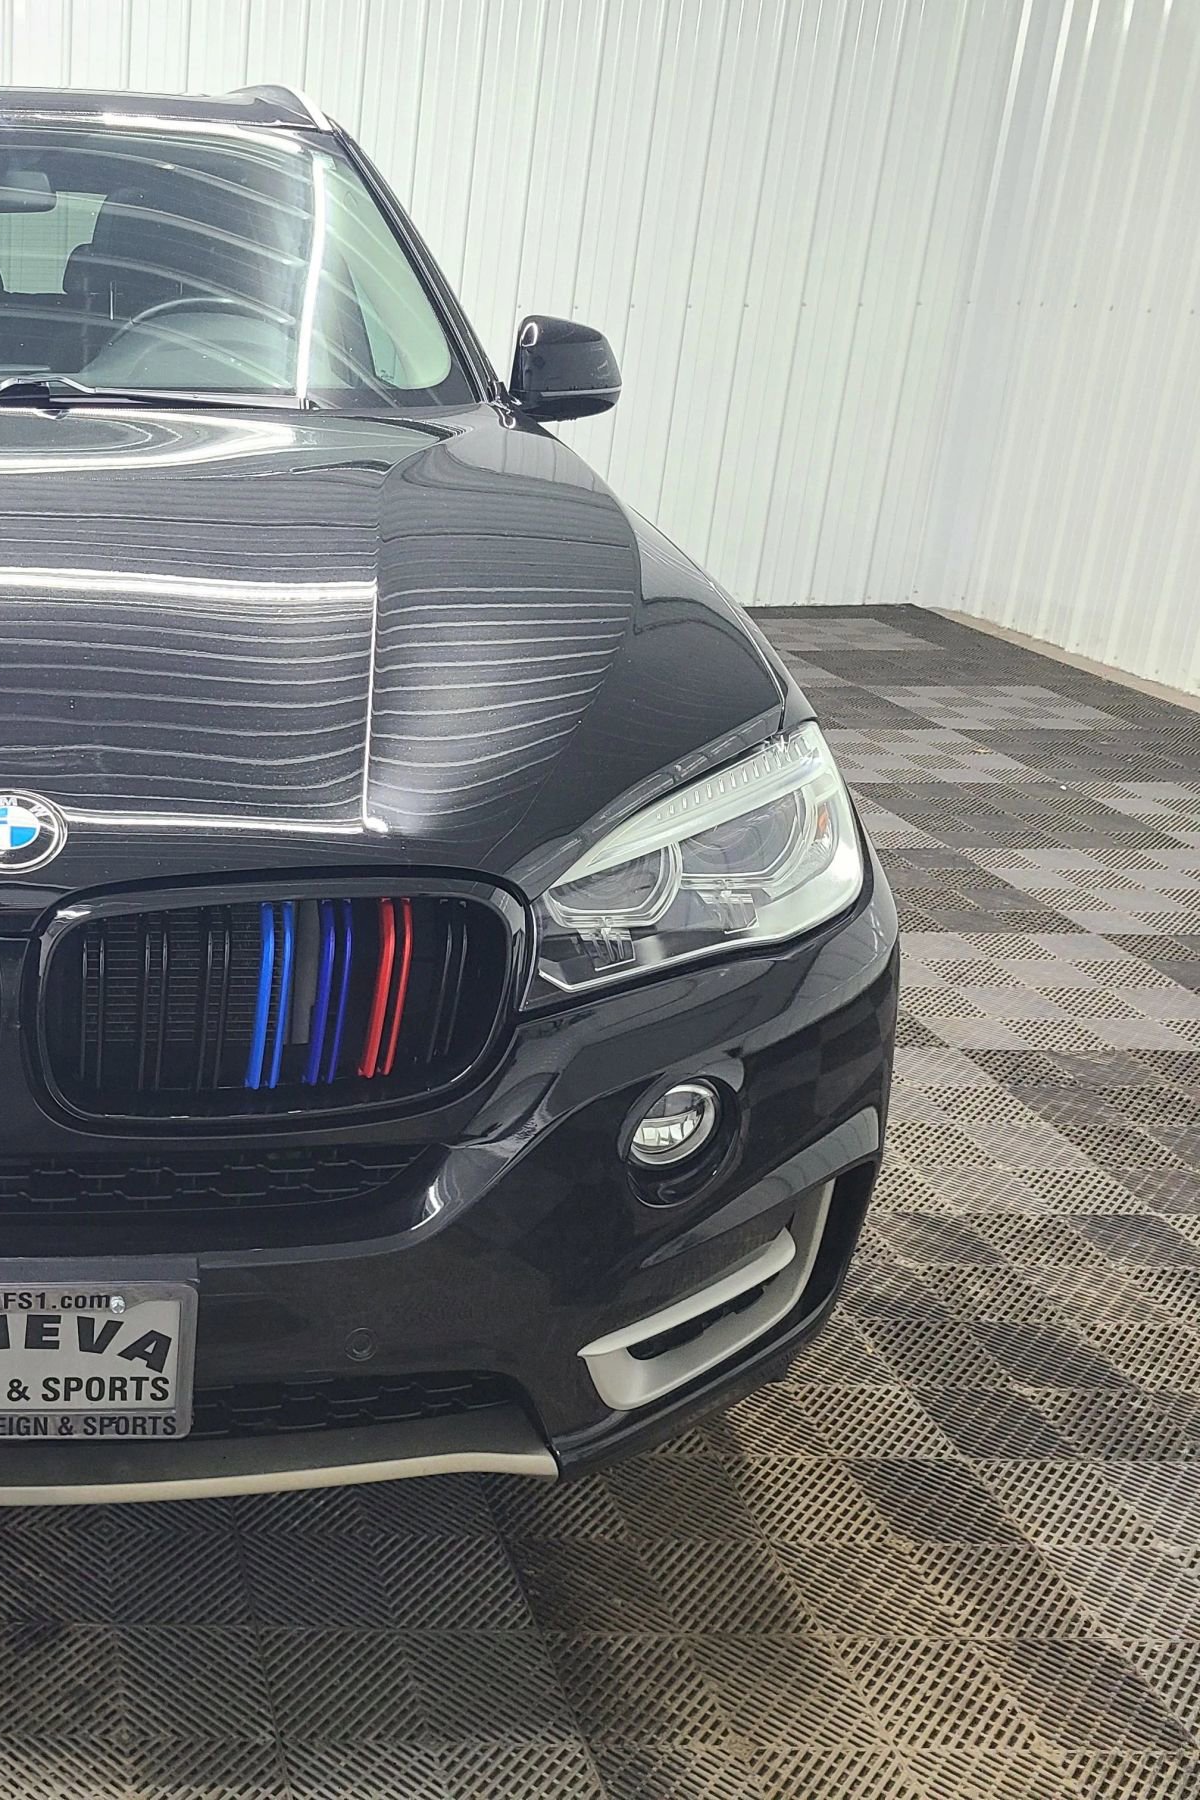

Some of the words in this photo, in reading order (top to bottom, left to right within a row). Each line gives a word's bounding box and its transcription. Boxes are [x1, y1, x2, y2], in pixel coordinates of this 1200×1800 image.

[7, 1378, 30, 1402] &
[42, 1376, 170, 1402] SPORTS
[58, 1417, 74, 1436] &
[84, 1416, 176, 1436] SPORTS
